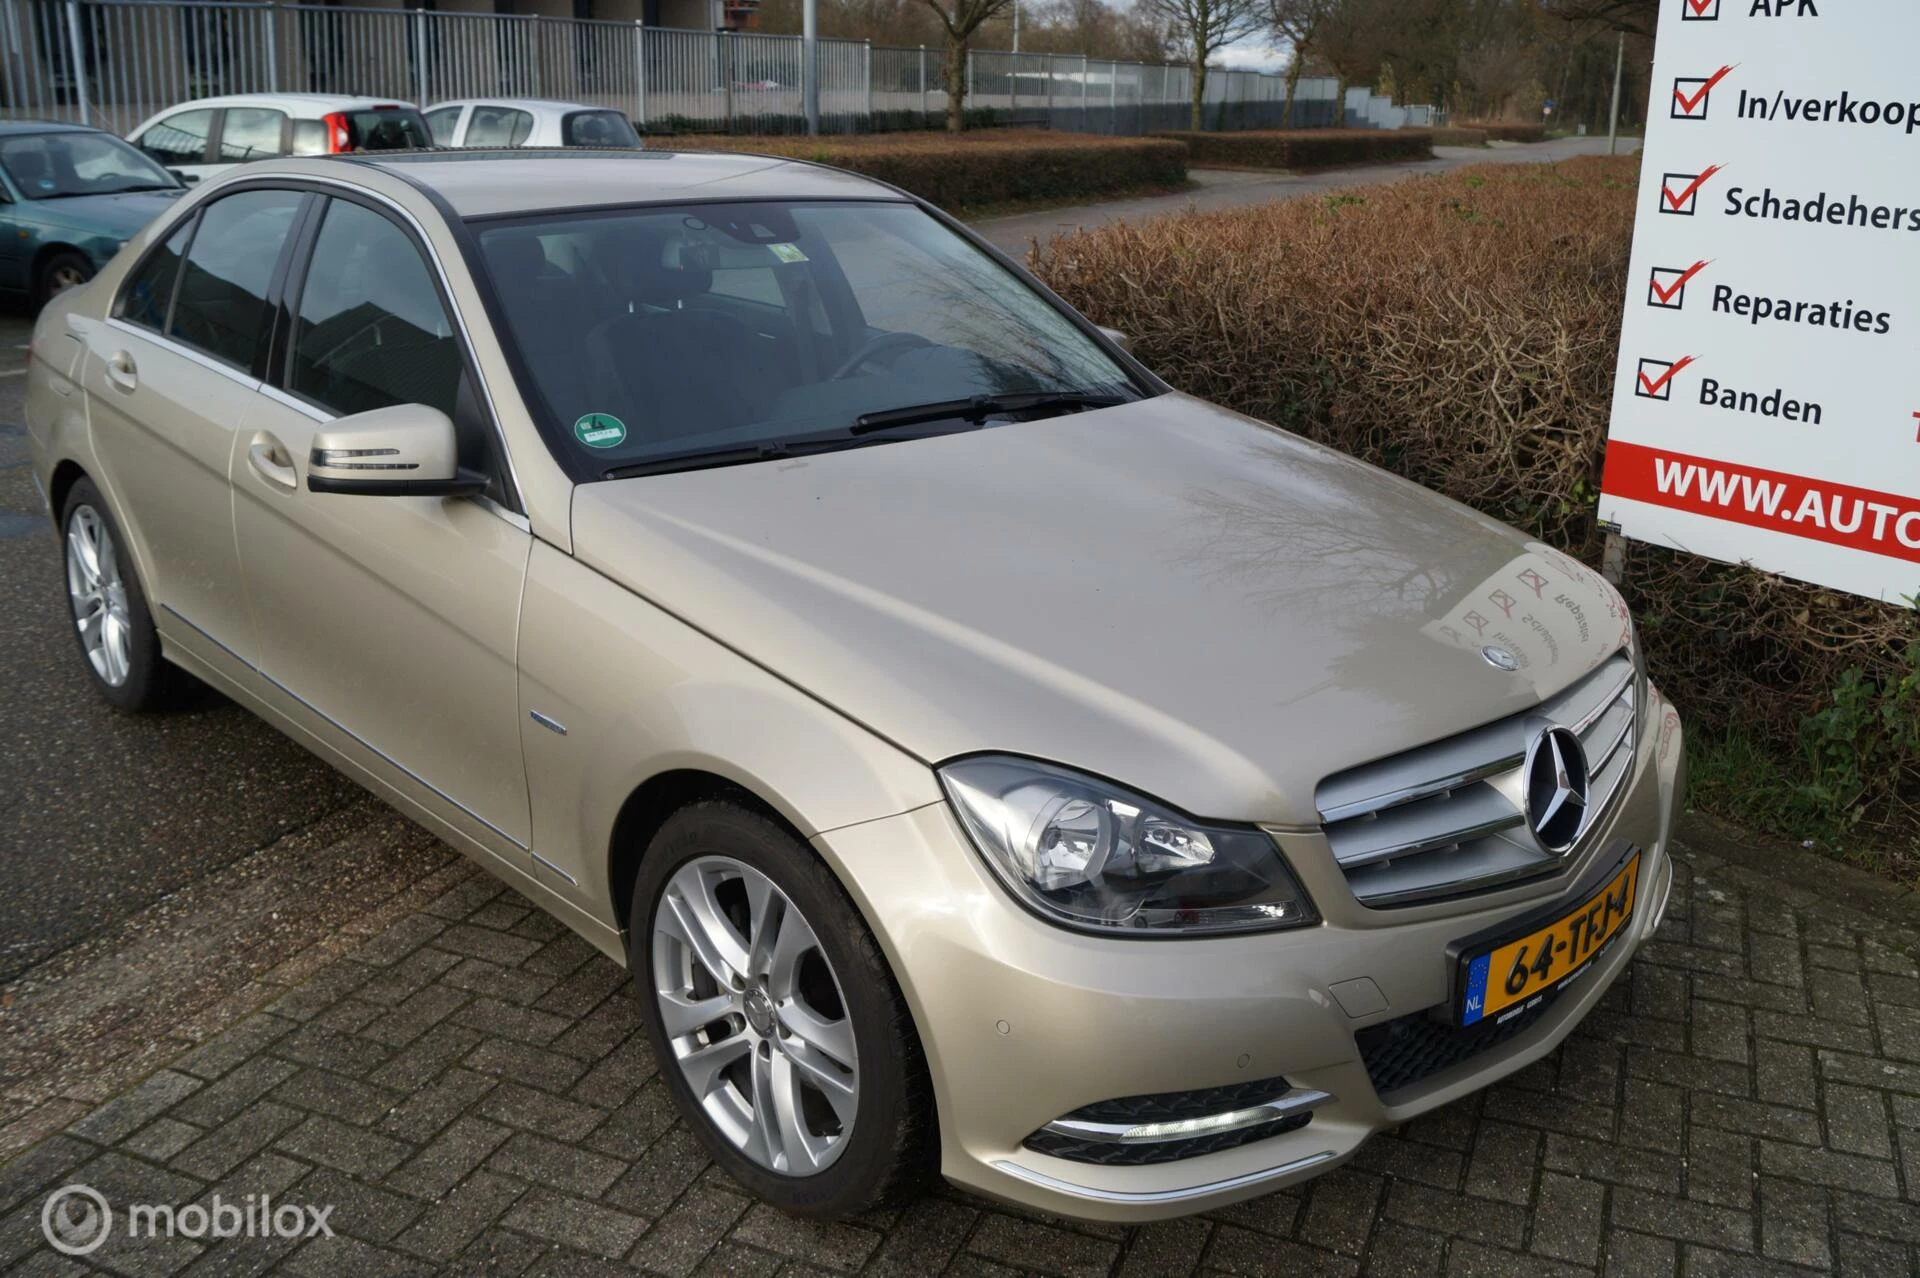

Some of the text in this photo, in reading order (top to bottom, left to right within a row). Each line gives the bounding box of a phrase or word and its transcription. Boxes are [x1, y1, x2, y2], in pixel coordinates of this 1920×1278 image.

[1748, 0, 1819, 18] APK
[1737, 89, 1920, 135] In/verkoop
[1724, 187, 1920, 232] Schadehers
[1712, 284, 1891, 335] Reparaties
[1699, 378, 1822, 425] Banden
[1505, 873, 1630, 995] 64-TFJ-4
[1466, 997, 1482, 1014] NL
